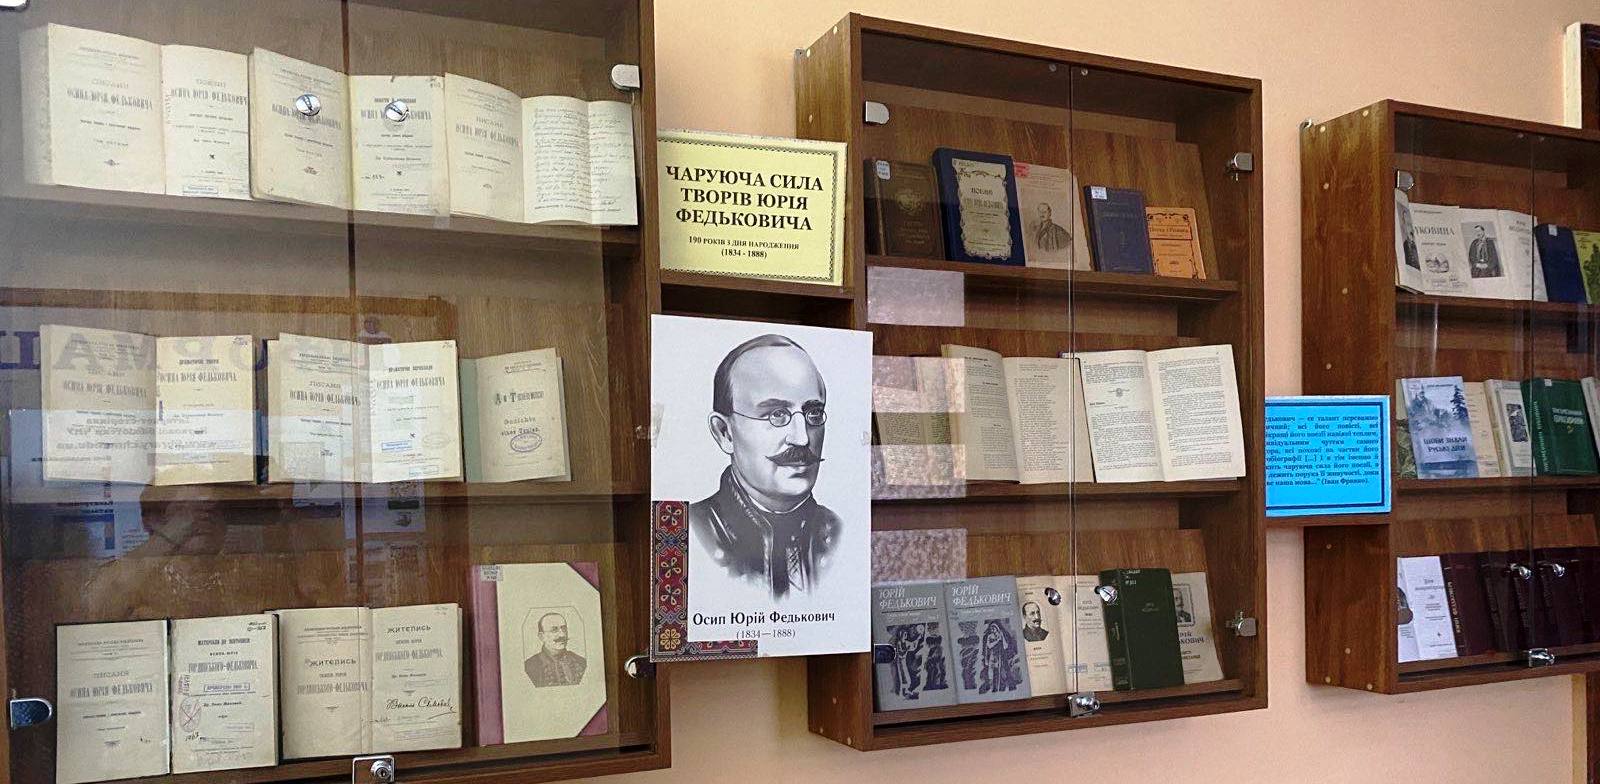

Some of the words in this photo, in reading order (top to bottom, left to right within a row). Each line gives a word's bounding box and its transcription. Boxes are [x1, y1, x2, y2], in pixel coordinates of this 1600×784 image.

[665, 165, 765, 187] ЧАРУЮЧА
[770, 174, 823, 191] СИЛА
[680, 187, 751, 206] ТВОРІВ
[757, 194, 808, 210] ЮРІЯ
[676, 208, 812, 231] ФЕДЬКОВИЧА
[1414, 225, 1455, 236] УКОВИНА
[689, 236, 702, 244] 190
[703, 237, 726, 246] РОКІВ
[732, 239, 747, 247] ДНЯ
[748, 241, 800, 250] НАРОДЖЕННЯ
[721, 249, 741, 257] (1834
[747, 250, 767, 259] 1888)
[1266, 455, 1302, 463] обіографії
[878, 586, 906, 600] ЮРІЙ
[952, 584, 980, 596] ЮРІЙ
[879, 596, 937, 610] ФЕДЬКОВИЧ
[953, 592, 1012, 606] ФЕДЬКОВИЧ
[693, 612, 726, 626] Осип
[730, 610, 765, 627] Юрій
[769, 610, 836, 625] Федькович
[736, 629, 796, 640] (1834—1888)
[1180, 636, 1205, 645] КОВИЧ
